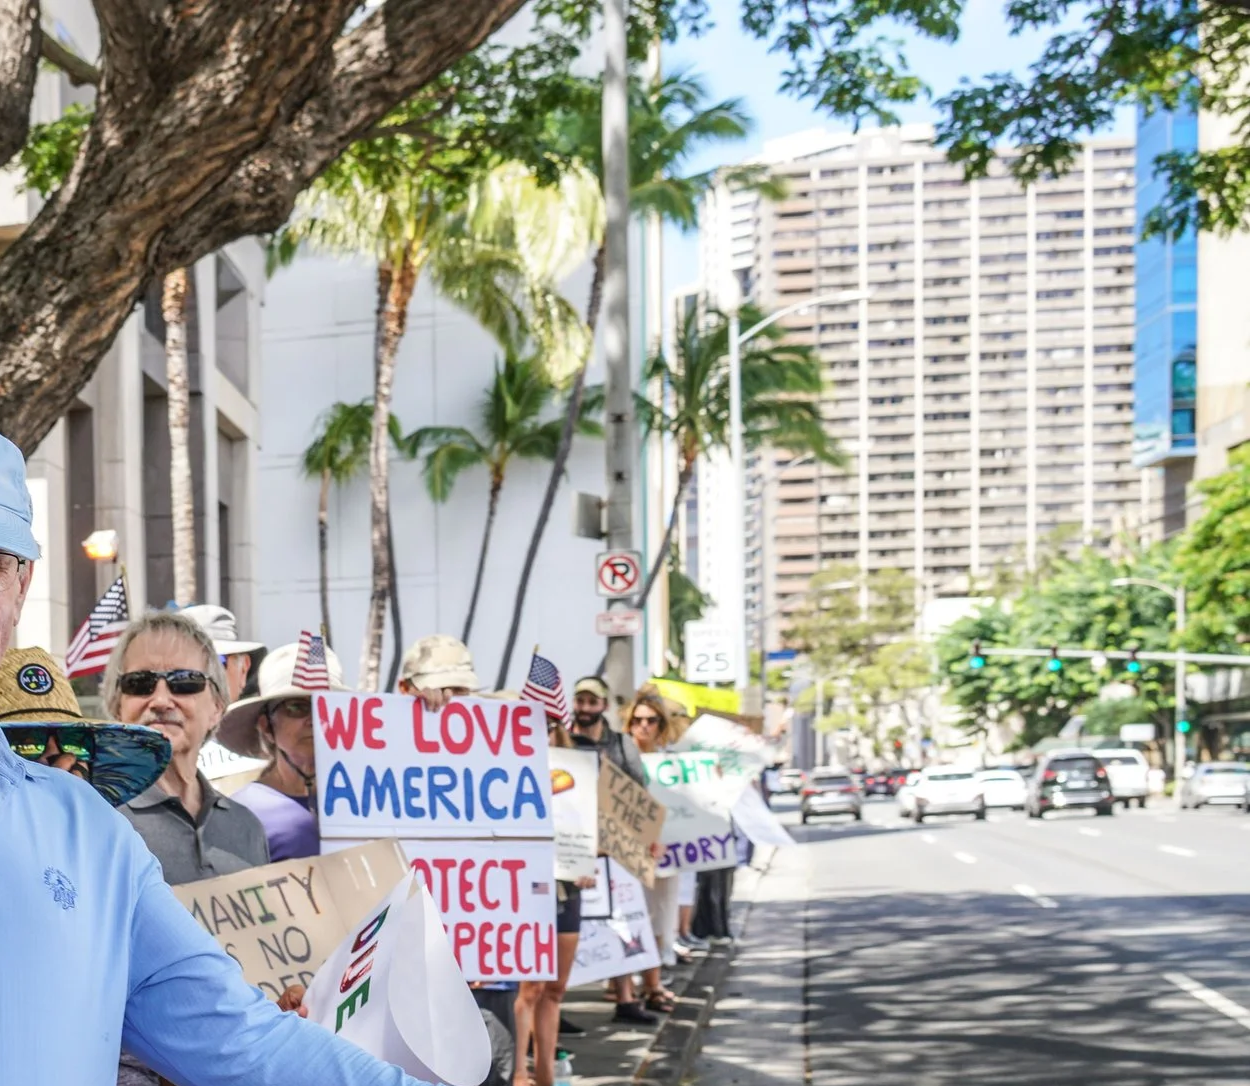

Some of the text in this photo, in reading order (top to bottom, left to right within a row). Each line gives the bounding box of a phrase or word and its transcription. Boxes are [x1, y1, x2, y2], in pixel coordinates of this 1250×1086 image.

[695, 652, 730, 672] 25
[317, 695, 535, 757] WE LOVE
[324, 761, 547, 822] AMERICA
[607, 764, 660, 822] TAKE
[611, 793, 643, 833] THE
[410, 858, 527, 914] OTECT
[257, 925, 312, 971] NO
[442, 921, 554, 976] PEECH
